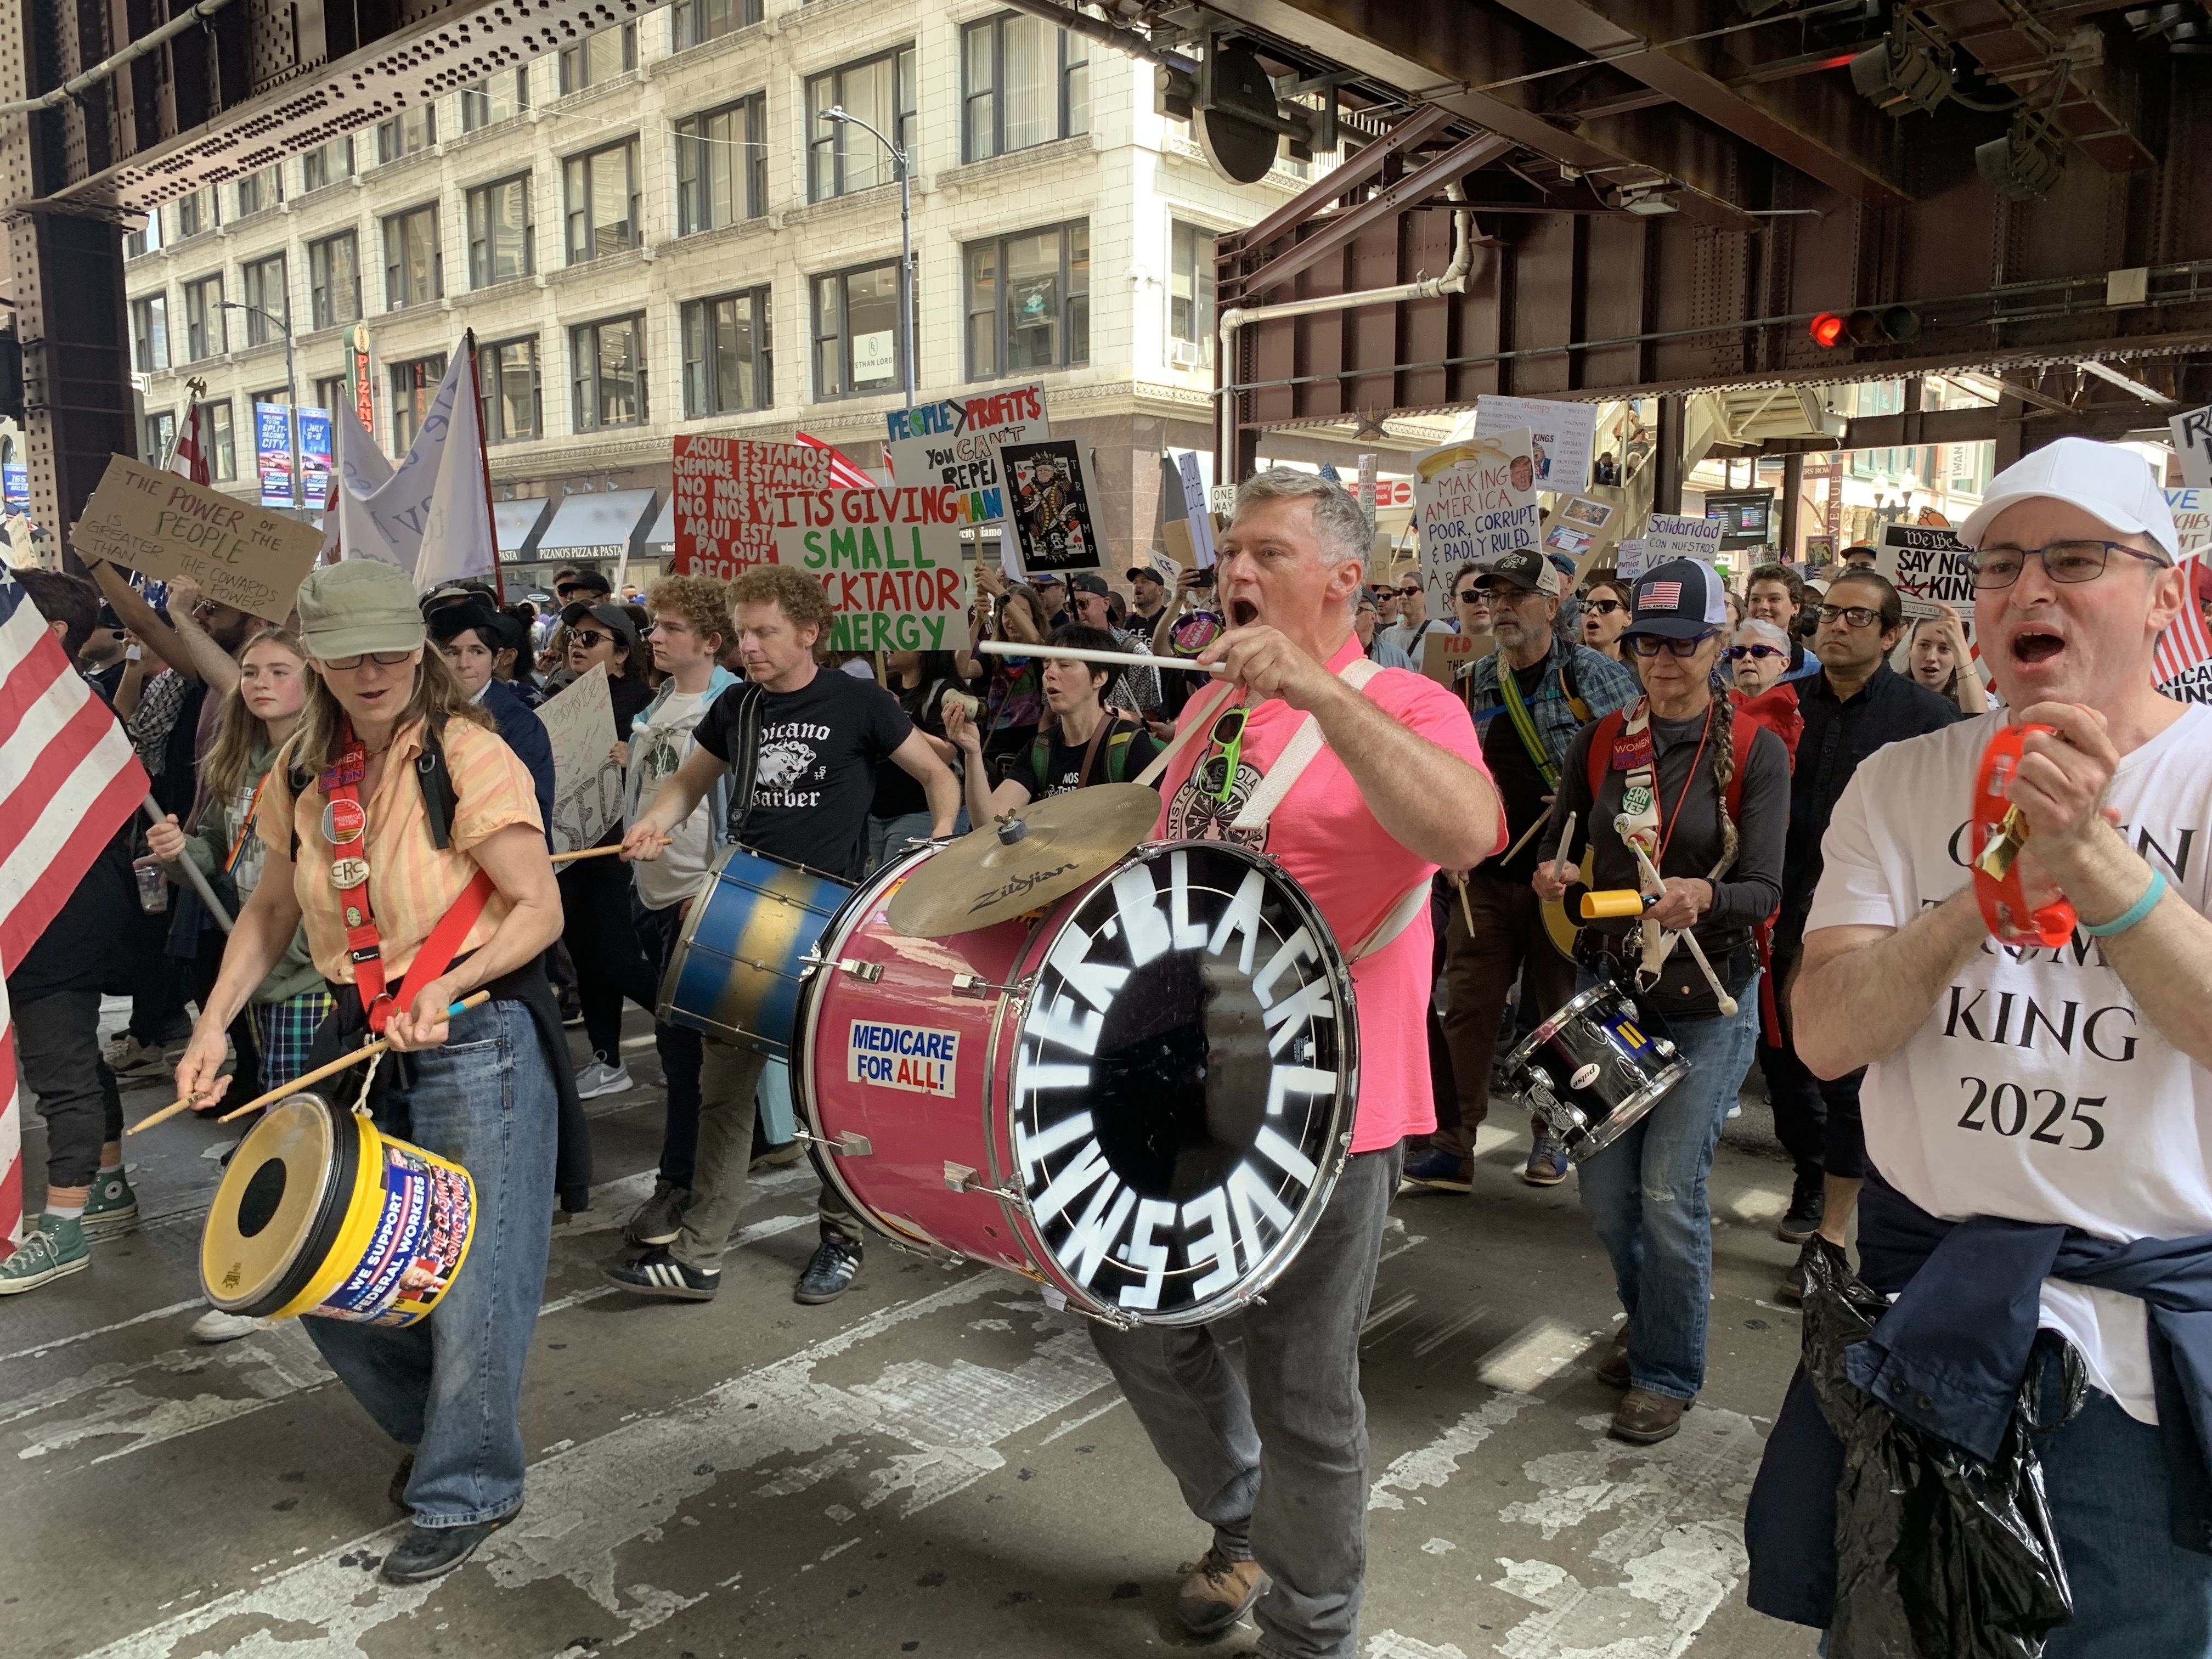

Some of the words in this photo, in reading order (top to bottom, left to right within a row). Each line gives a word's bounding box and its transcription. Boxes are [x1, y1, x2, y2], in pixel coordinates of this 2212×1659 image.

[855, 360, 875, 369] ETHAN
[877, 357, 893, 365] LORD
[357, 354, 373, 434] PIZANO
[262, 425, 287, 433] SPLIT-
[887, 401, 953, 442] PEOPLE
[262, 438, 286, 449] CITY
[1533, 433, 1554, 443] KINGS
[684, 437, 729, 459] AQUI
[738, 441, 831, 470] ESTAMOS
[1953, 446, 1963, 476] IWAN
[12, 475, 26, 483] 165
[673, 455, 733, 479] SIEMPRE
[739, 462, 830, 488] ESTAMOS
[1438, 466, 1509, 498] MAKING
[125, 471, 163, 495] THE
[167, 487, 244, 533] POWER
[260, 520, 278, 532] OF
[678, 476, 706, 495] NO
[714, 479, 749, 501] NOS
[1214, 489, 1233, 500] ONE
[678, 496, 707, 516] NO
[713, 499, 751, 523] NOS
[775, 489, 834, 527] IT'S
[842, 485, 958, 524] GIVING
[1214, 502, 1233, 512] WAY
[1426, 488, 1512, 523] AMERICA
[106, 514, 121, 527] IS
[684, 517, 730, 539] AQUI
[1429, 520, 1471, 541] POOR,
[1475, 504, 1537, 534] CORRUPT,
[1649, 515, 1721, 539] Solidaridad
[86, 521, 165, 560] GREATER
[94, 539, 136, 563] THAN
[154, 511, 250, 564] PEOPLE
[250, 528, 282, 552] THE
[540, 547, 571, 559] PIZANO'S
[572, 546, 592, 557] PIZZA
[592, 548, 599, 557] &
[600, 545, 622, 556] PASTA
[696, 535, 720, 557] PA
[731, 540, 770, 563] QUE
[804, 526, 936, 569] SMALL
[1444, 537, 1487, 563] BADLY
[1492, 527, 1539, 554] RULED...
[1650, 538, 1667, 549] CON
[1672, 540, 1715, 554] NUESTROS
[1154, 556, 1175, 575] ICE
[1898, 549, 1936, 573] SAY
[180, 554, 208, 575] THE
[210, 567, 279, 603] COWARDS
[820, 568, 961, 612] CKTATOR
[1427, 568, 1442, 591] A
[211, 584, 266, 613] POWER
[830, 612, 946, 651] NERGY
[332, 751, 362, 767] MEN
[1615, 737, 1650, 753] WOMEN
[1062, 772, 1079, 784] NOS
[1623, 800, 1645, 815] YES
[1627, 786, 1649, 804] ERA
[334, 812, 362, 822] MOONRISE
[331, 861, 364, 881] CRC
[967, 862, 1079, 915] Zildjian
[1943, 986, 2140, 1062] KING
[853, 1025, 956, 1061] MEDICARE
[858, 1054, 893, 1082] FOR
[897, 1058, 945, 1091] ALL!
[1573, 1065, 1595, 1088] pulse
[1957, 1077, 2108, 1150] 2025
[435, 1178, 450, 1228] CLOWN
[347, 1268, 373, 1290] WE
[368, 1192, 403, 1265] SUPPORT
[353, 1258, 405, 1312] FEDERAL
[397, 1176, 426, 1254] WORKERS
[428, 1227, 447, 1258] THE
[445, 1220, 467, 1267] GOING
